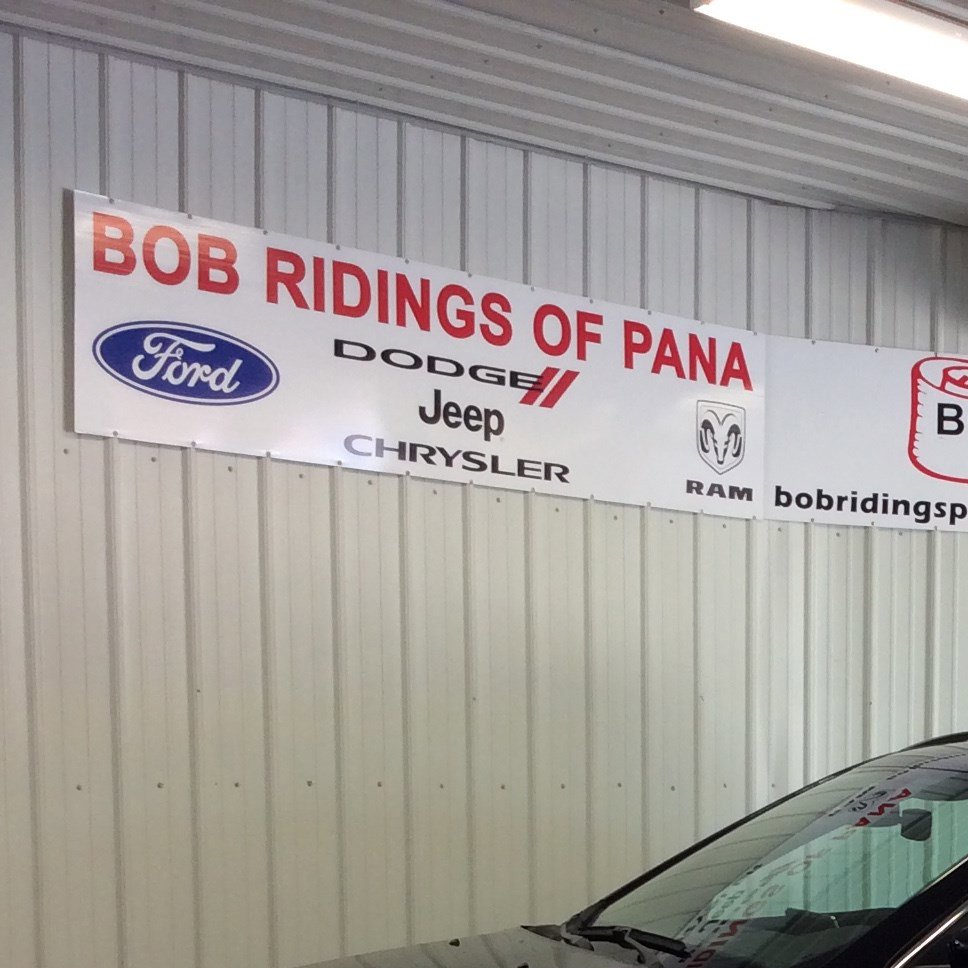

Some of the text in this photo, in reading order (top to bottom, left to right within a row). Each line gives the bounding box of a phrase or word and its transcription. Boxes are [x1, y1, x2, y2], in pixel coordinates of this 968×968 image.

[93, 212, 753, 392] BOB RIDINGS OF PANA
[131, 332, 243, 394] Ford
[333, 338, 546, 394] DODGE
[418, 388, 505, 442] Jeep
[343, 433, 570, 484] CHRYSLER
[685, 479, 753, 502] RAM
